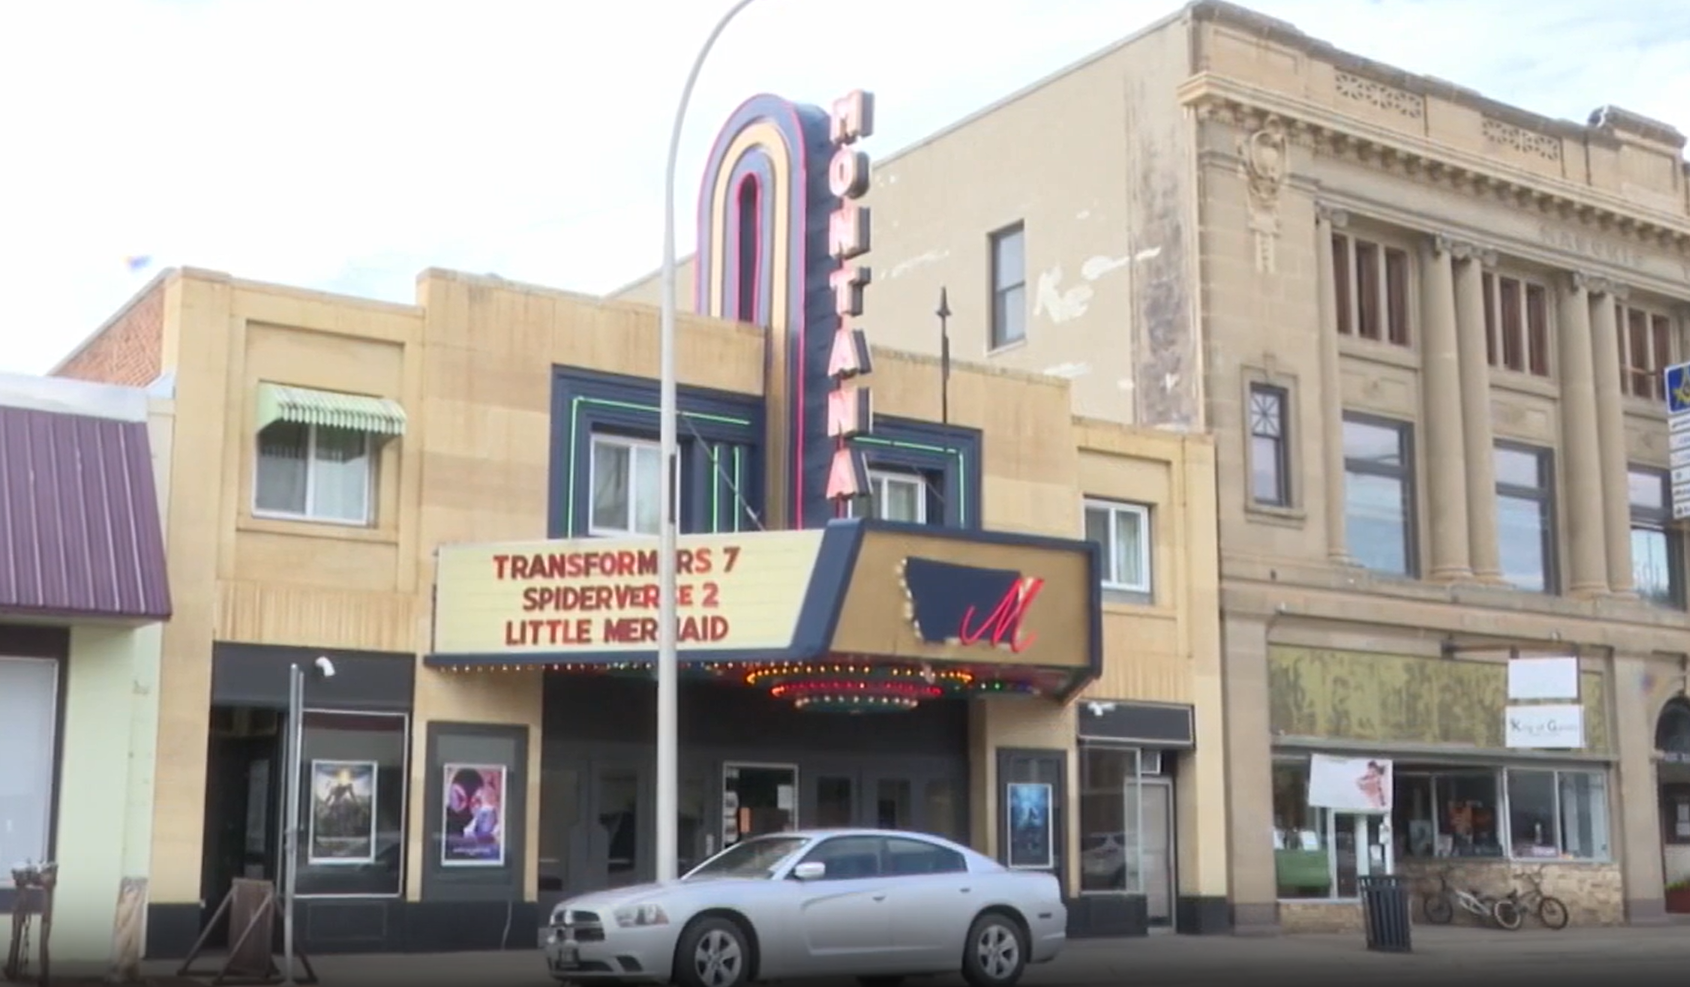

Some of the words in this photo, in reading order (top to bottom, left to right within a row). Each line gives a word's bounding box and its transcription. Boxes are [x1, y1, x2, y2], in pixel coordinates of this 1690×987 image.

[827, 88, 875, 500] MONTANA
[493, 547, 712, 580] TRANSFORMRS
[721, 546, 741, 573] 7
[522, 583, 694, 612] SPIDERVERE
[701, 581, 719, 608] 2
[505, 619, 593, 646] LITTLE
[603, 615, 729, 644] MERAID
